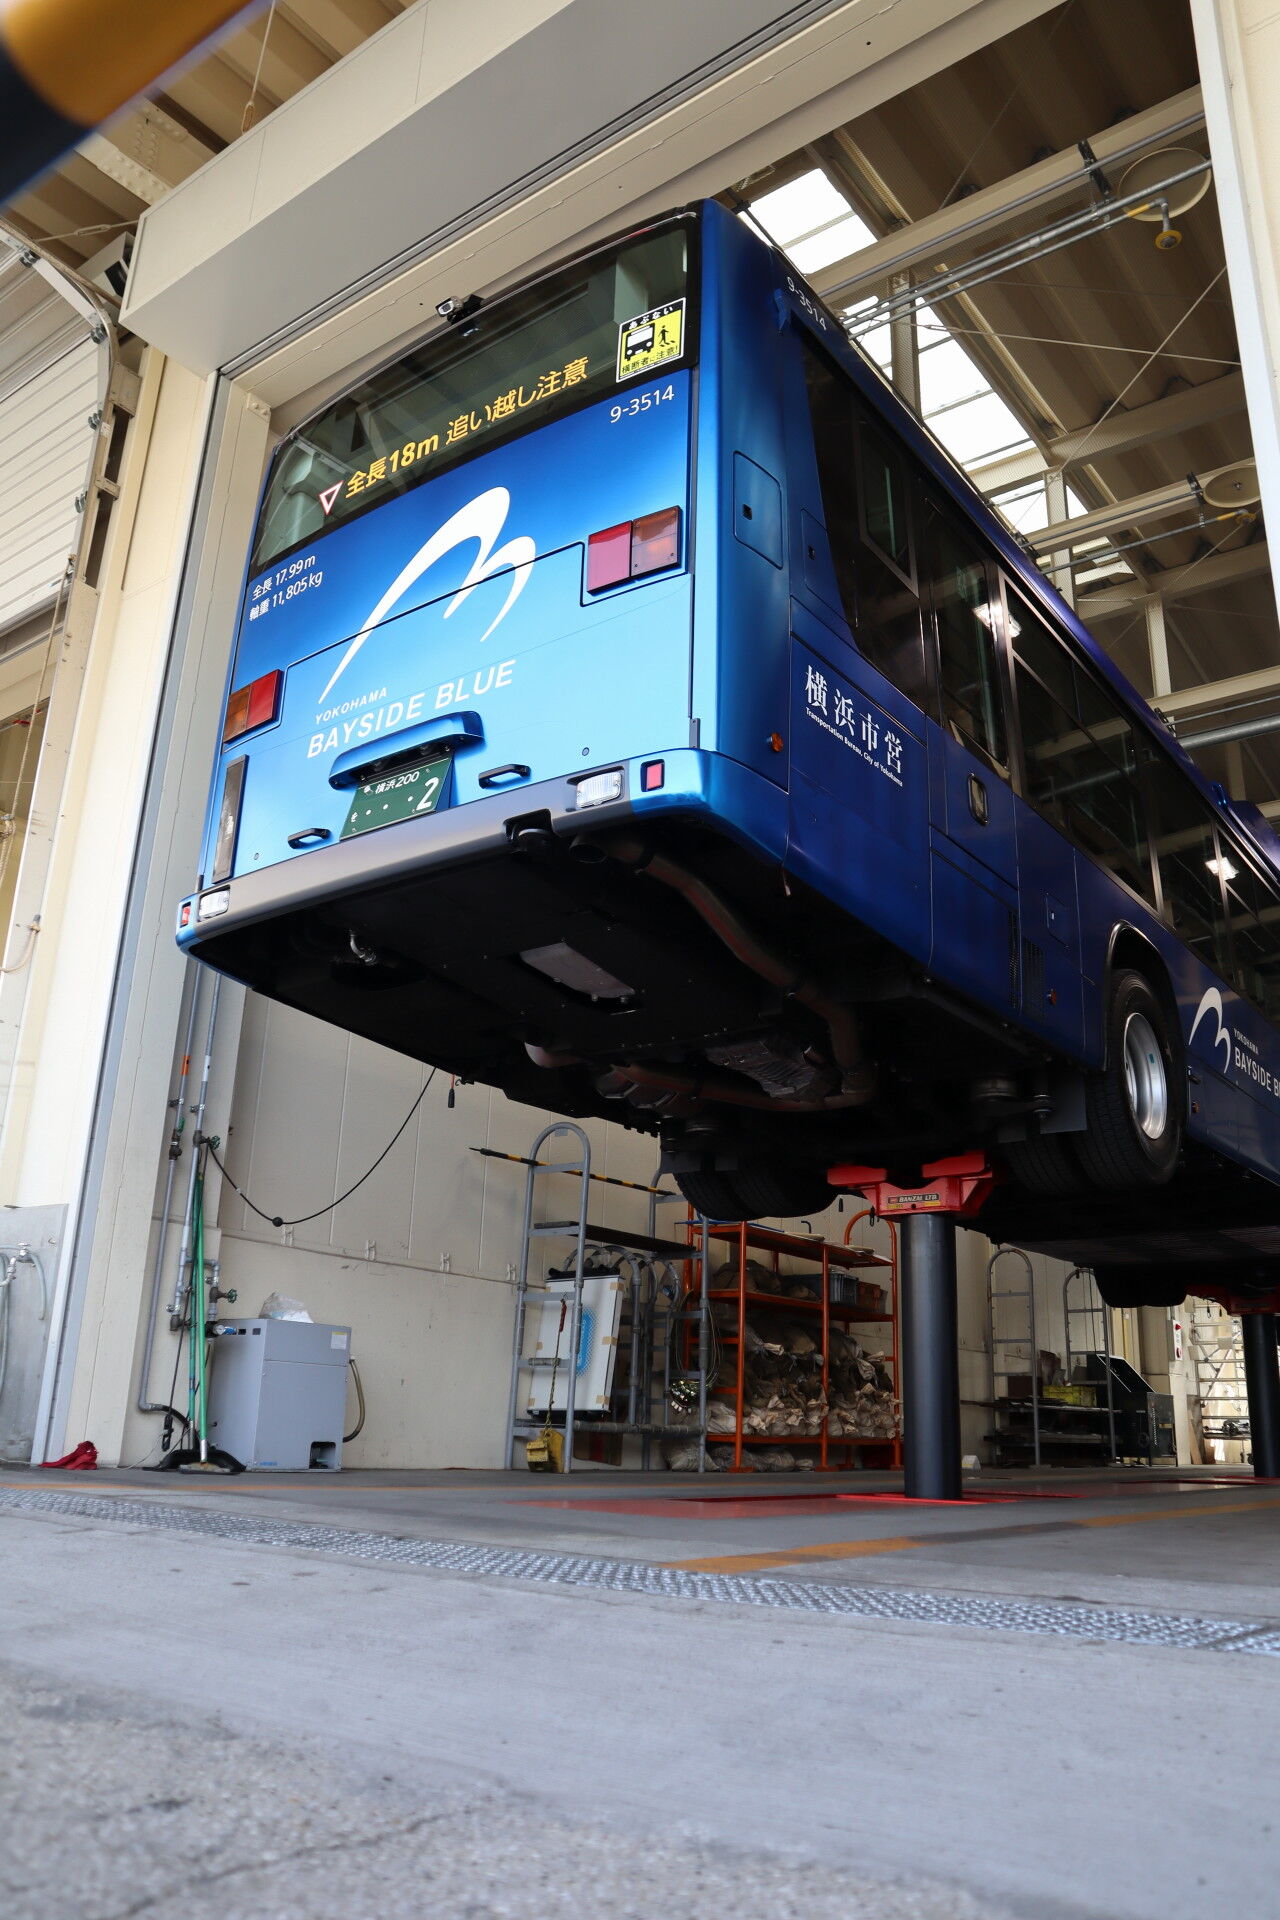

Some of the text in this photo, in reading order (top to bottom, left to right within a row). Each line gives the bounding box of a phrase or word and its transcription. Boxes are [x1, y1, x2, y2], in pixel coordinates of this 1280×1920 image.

[628, 306, 674, 330] あぶない
[787, 276, 827, 331] 9-3514
[445, 356, 589, 446] 追い越し注意
[610, 384, 675, 423] 9-3514
[252, 555, 316, 601] 全長 17.99m
[248, 598, 270, 621] 軸重
[306, 659, 517, 759] BAYSIDE BLUE
[315, 687, 388, 725] YOKOHAMA
[805, 664, 903, 774] 横浜市営
[805, 706, 844, 742] Transportation
[863, 751, 874, 766] City
[873, 760, 880, 769] of
[880, 763, 903, 787] Yokohama
[375, 771, 420, 795] 横浜200
[1233, 1027, 1259, 1056] YOKOHAMA
[1234, 1046, 1273, 1092] BAYSIDE
[899, 1195, 923, 1203] BANZAI
